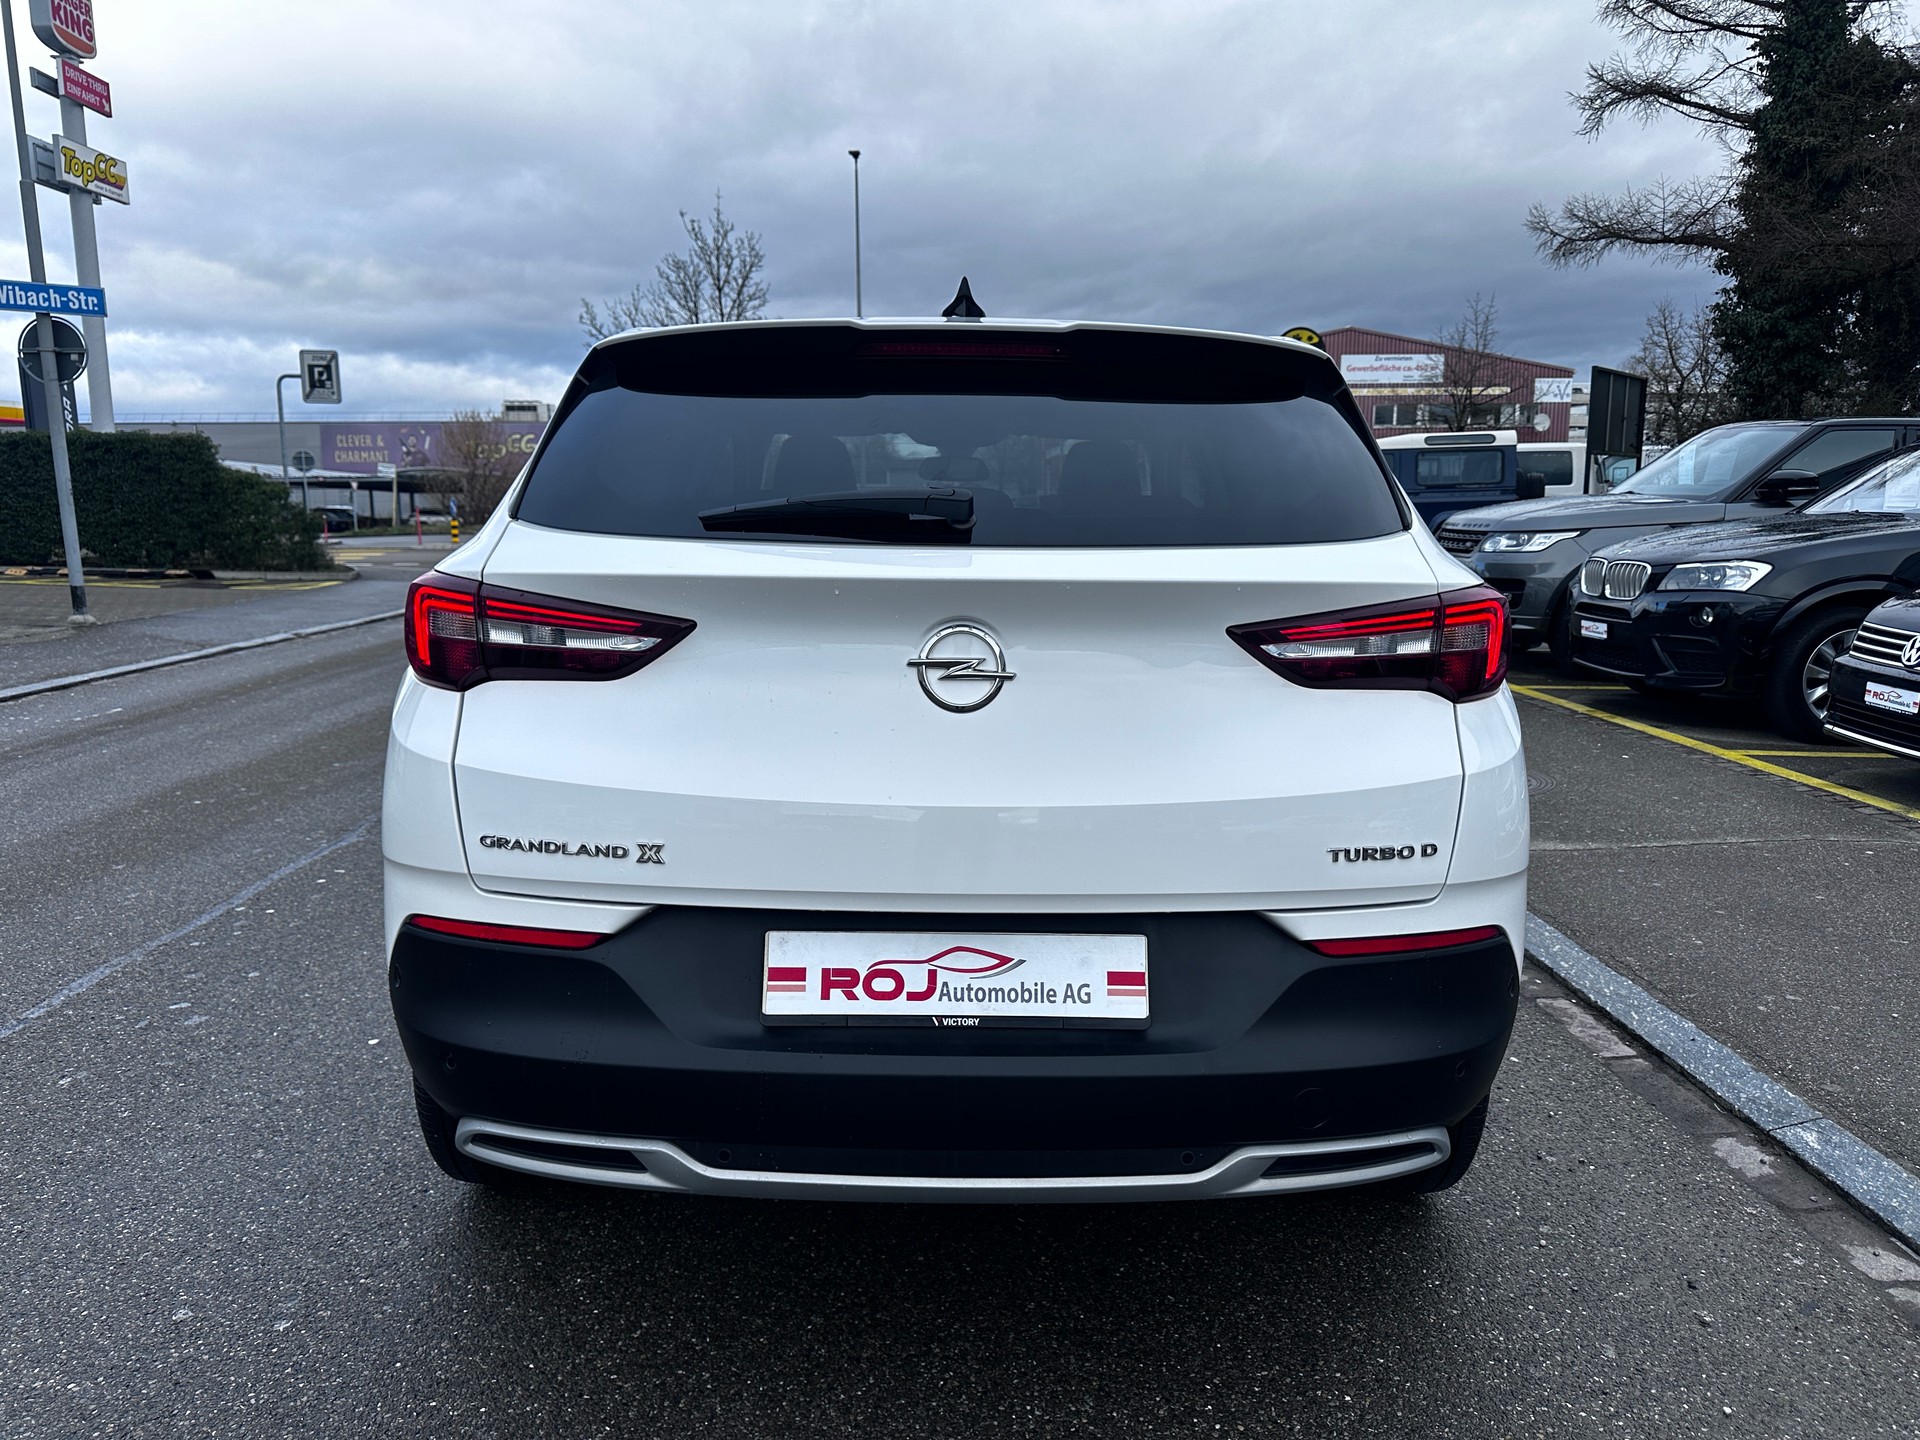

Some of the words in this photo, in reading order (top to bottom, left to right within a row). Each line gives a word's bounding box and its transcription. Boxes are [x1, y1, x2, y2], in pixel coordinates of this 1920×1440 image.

[51, 0, 94, 43] KING
[65, 65, 88, 86] DRIVE
[87, 76, 108, 96] THRU
[66, 82, 100, 106] EINFAHRT
[61, 145, 118, 187] TopCC
[336, 433, 373, 448] CLEVER
[376, 433, 385, 448] &
[334, 450, 389, 464] CHARMANT
[1872, 691, 1890, 702] ROJ
[479, 834, 630, 859] GRANDLAND
[636, 842, 665, 864] X
[1326, 845, 1415, 862] TURBO
[1420, 842, 1438, 857] D
[820, 967, 937, 1001] ROJ
[937, 981, 1057, 1004] Automobile
[1062, 982, 1091, 1004] AG
[942, 1017, 980, 1026] VICTORY
